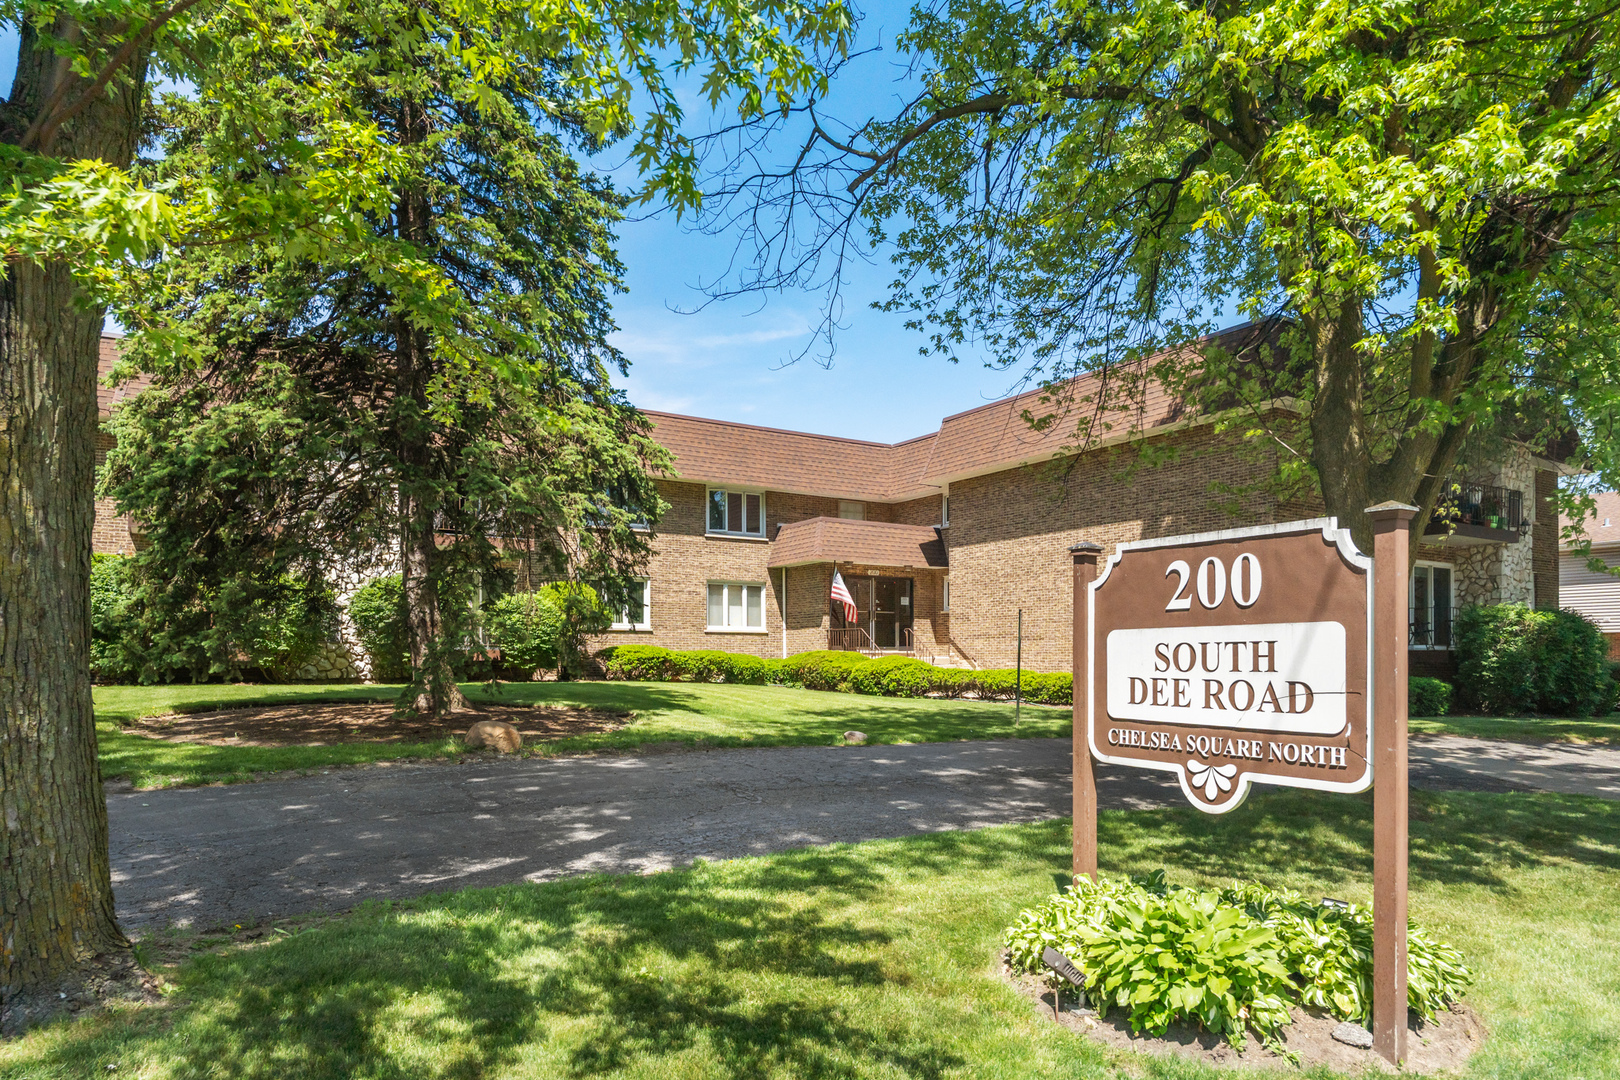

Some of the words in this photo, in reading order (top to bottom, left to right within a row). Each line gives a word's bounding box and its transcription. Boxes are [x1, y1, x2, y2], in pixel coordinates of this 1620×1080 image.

[1165, 552, 1263, 611] 200
[1154, 640, 1279, 673] SOUTH
[1127, 676, 1192, 708] DEE
[1202, 679, 1315, 715] ROAD
[1107, 728, 1183, 751] CHELSEA
[1186, 734, 1264, 760] SQUARE
[1268, 742, 1348, 768] NORTH
